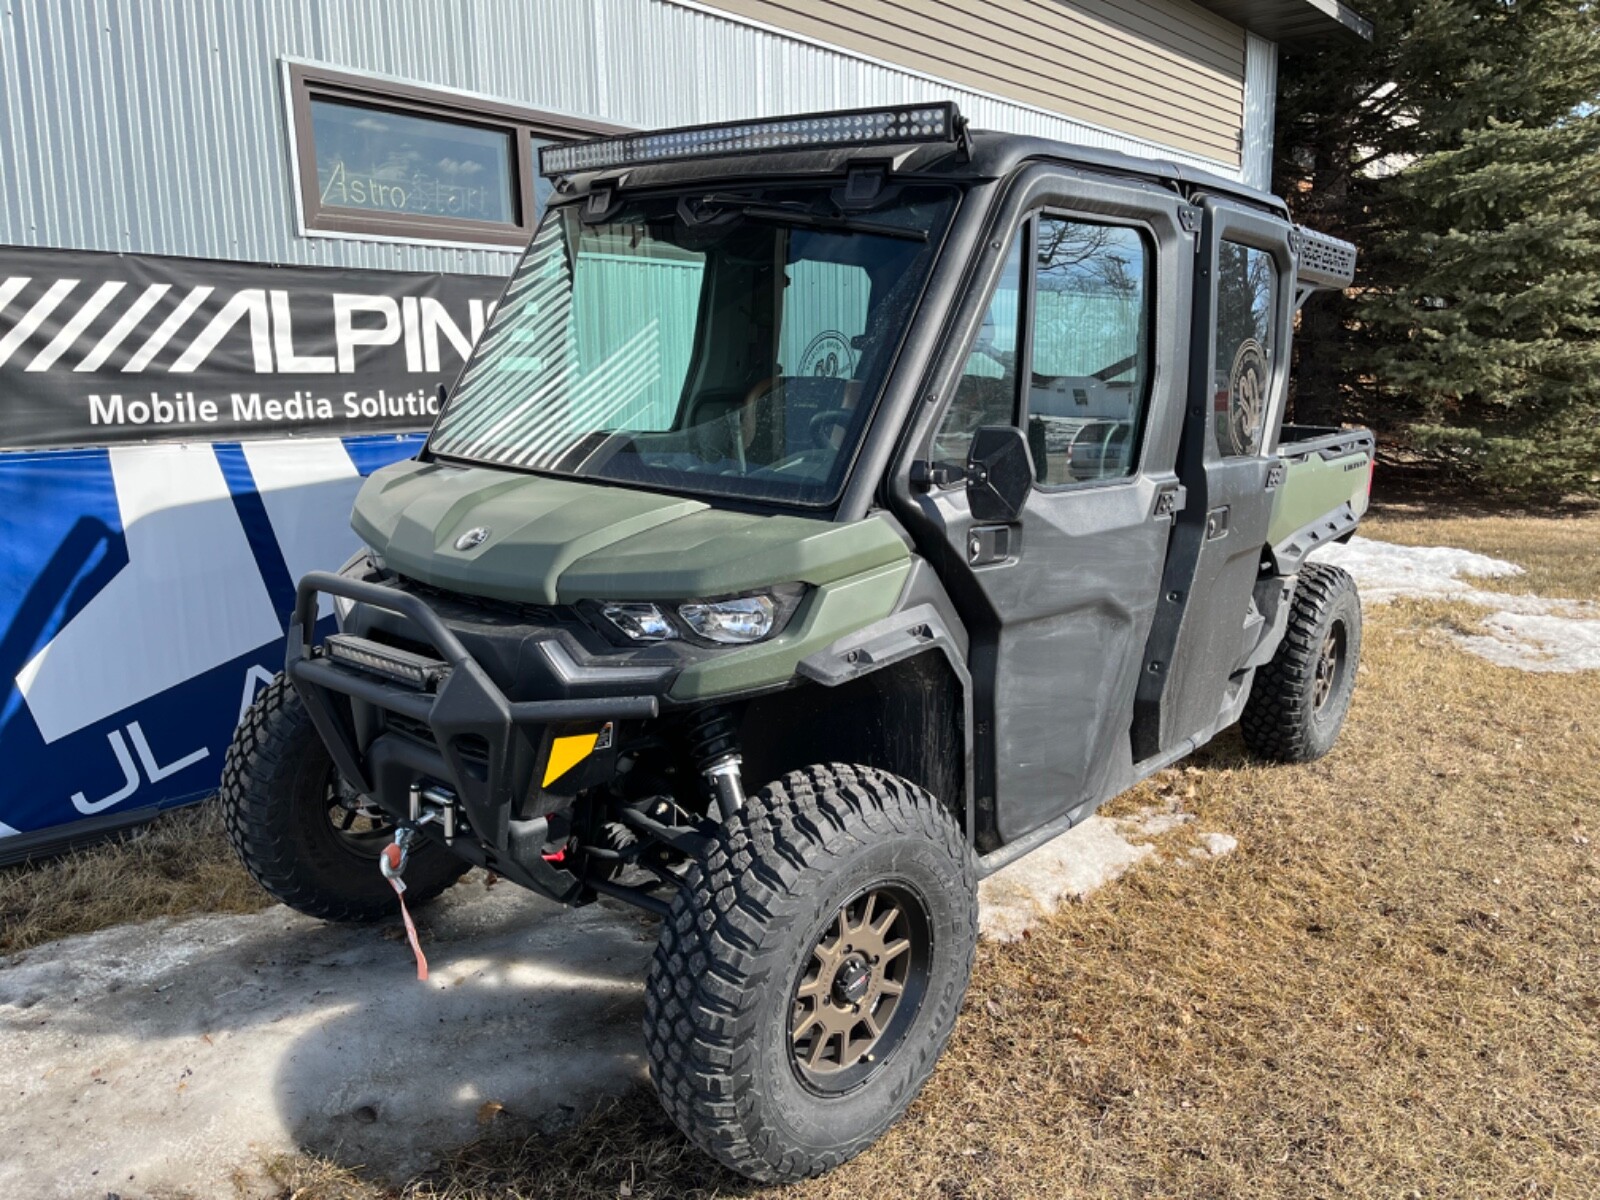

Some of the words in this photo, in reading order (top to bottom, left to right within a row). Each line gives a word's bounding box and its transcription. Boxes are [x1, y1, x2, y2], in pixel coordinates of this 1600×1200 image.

[320, 160, 406, 209] Astro
[168, 286, 499, 374] ALPIN
[88, 391, 219, 426] Mobile
[232, 391, 334, 422] Media
[70, 720, 211, 816] JL
